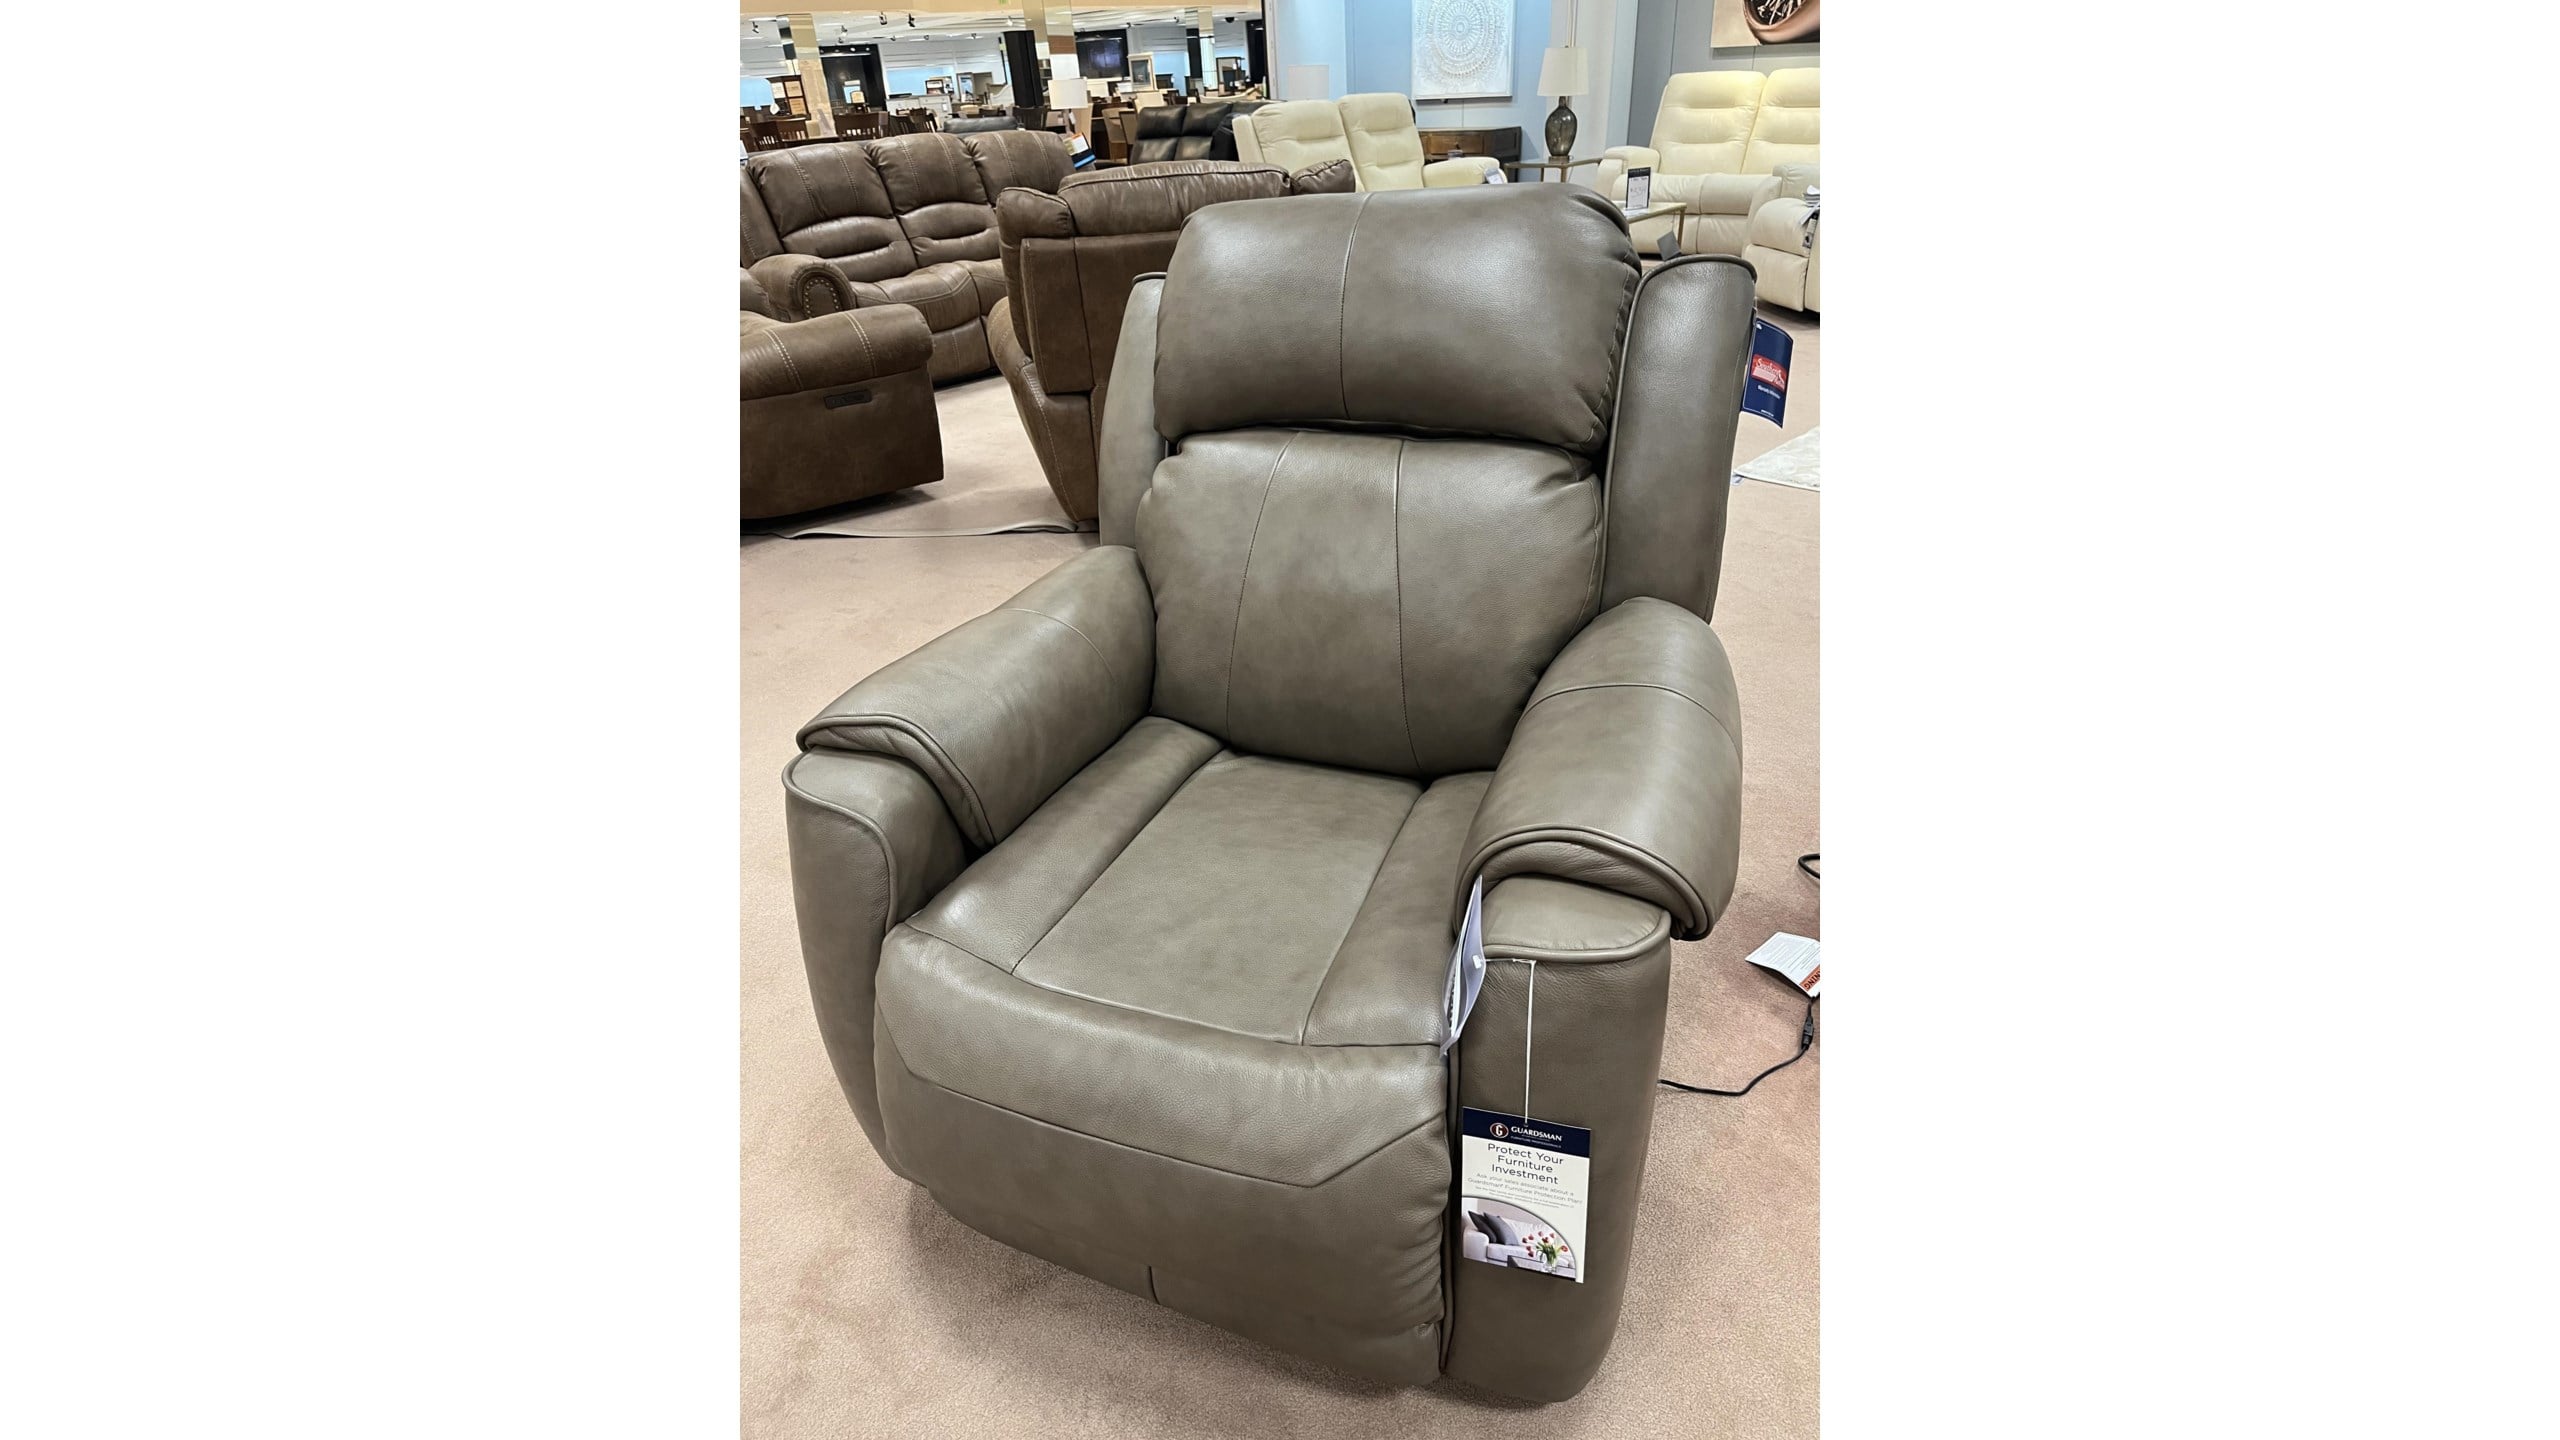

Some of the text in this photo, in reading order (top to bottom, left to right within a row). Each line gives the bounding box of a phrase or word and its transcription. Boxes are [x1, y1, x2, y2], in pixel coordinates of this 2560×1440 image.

[1511, 1126, 1562, 1141] GUARDSMAN
[1487, 1143, 1564, 1164] Protect Your
[1497, 1155, 1553, 1173] Furniture
[1491, 1164, 1559, 1184] Investment
